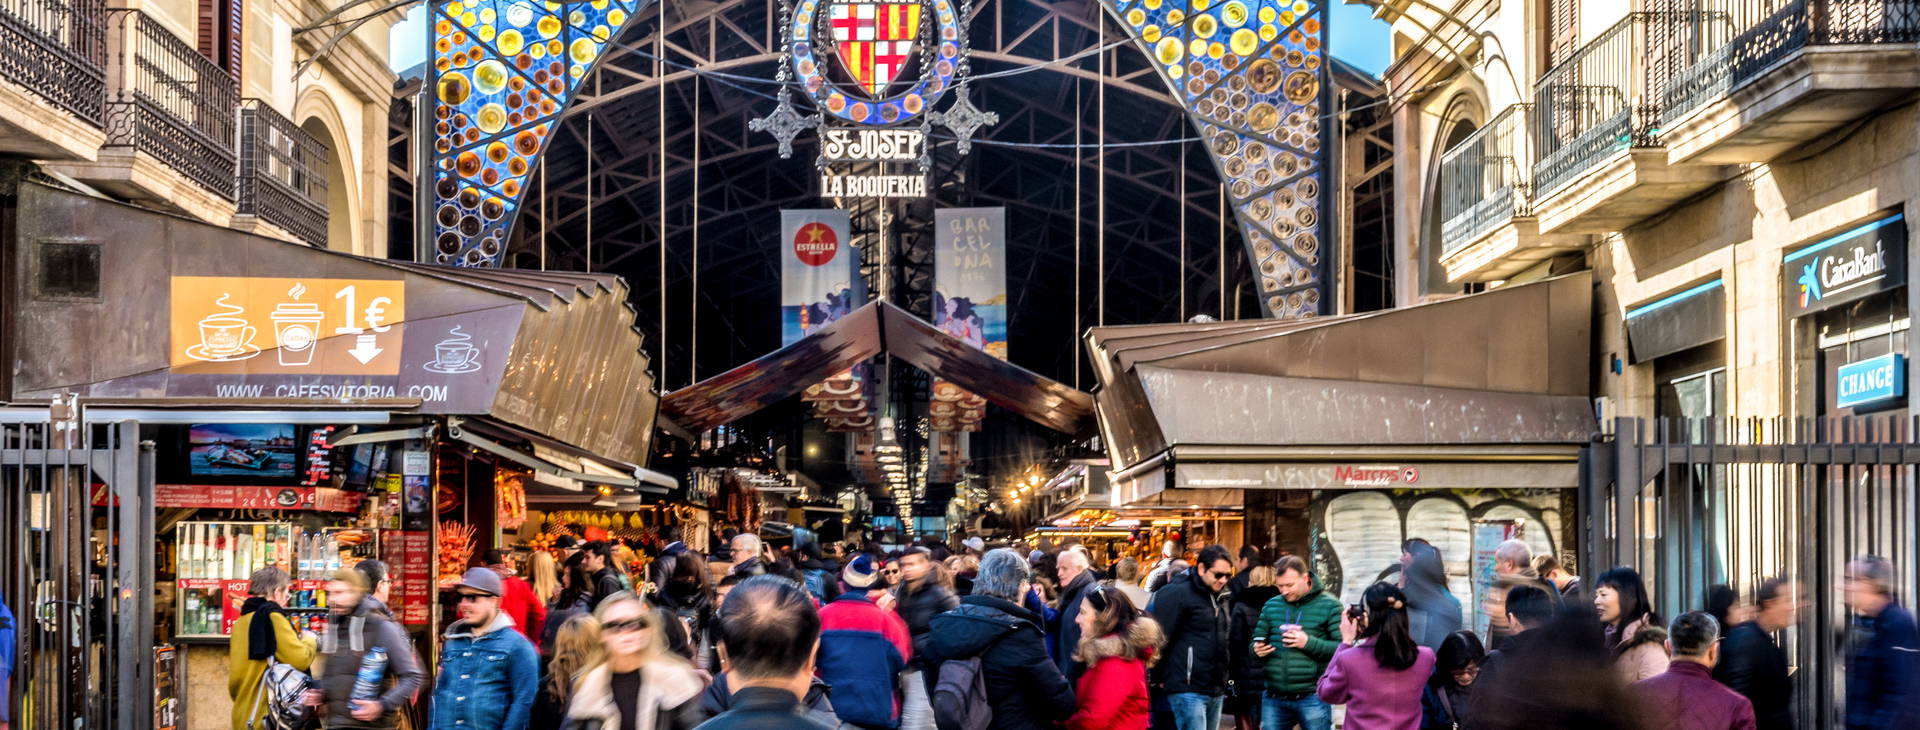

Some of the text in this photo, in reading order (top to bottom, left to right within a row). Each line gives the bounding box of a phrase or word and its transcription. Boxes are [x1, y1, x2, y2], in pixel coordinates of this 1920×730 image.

[848, 130, 923, 159] JOSEP
[821, 175, 927, 197] LA BOQUERIA
[797, 243, 835, 251] ESTRELLA
[1821, 239, 1887, 288] CaixaBank
[335, 285, 392, 334] 1€
[408, 384, 448, 401] COM
[1840, 366, 1893, 397] CHANGE
[1333, 465, 1399, 482] Marcos
[228, 582, 249, 591] HOT
